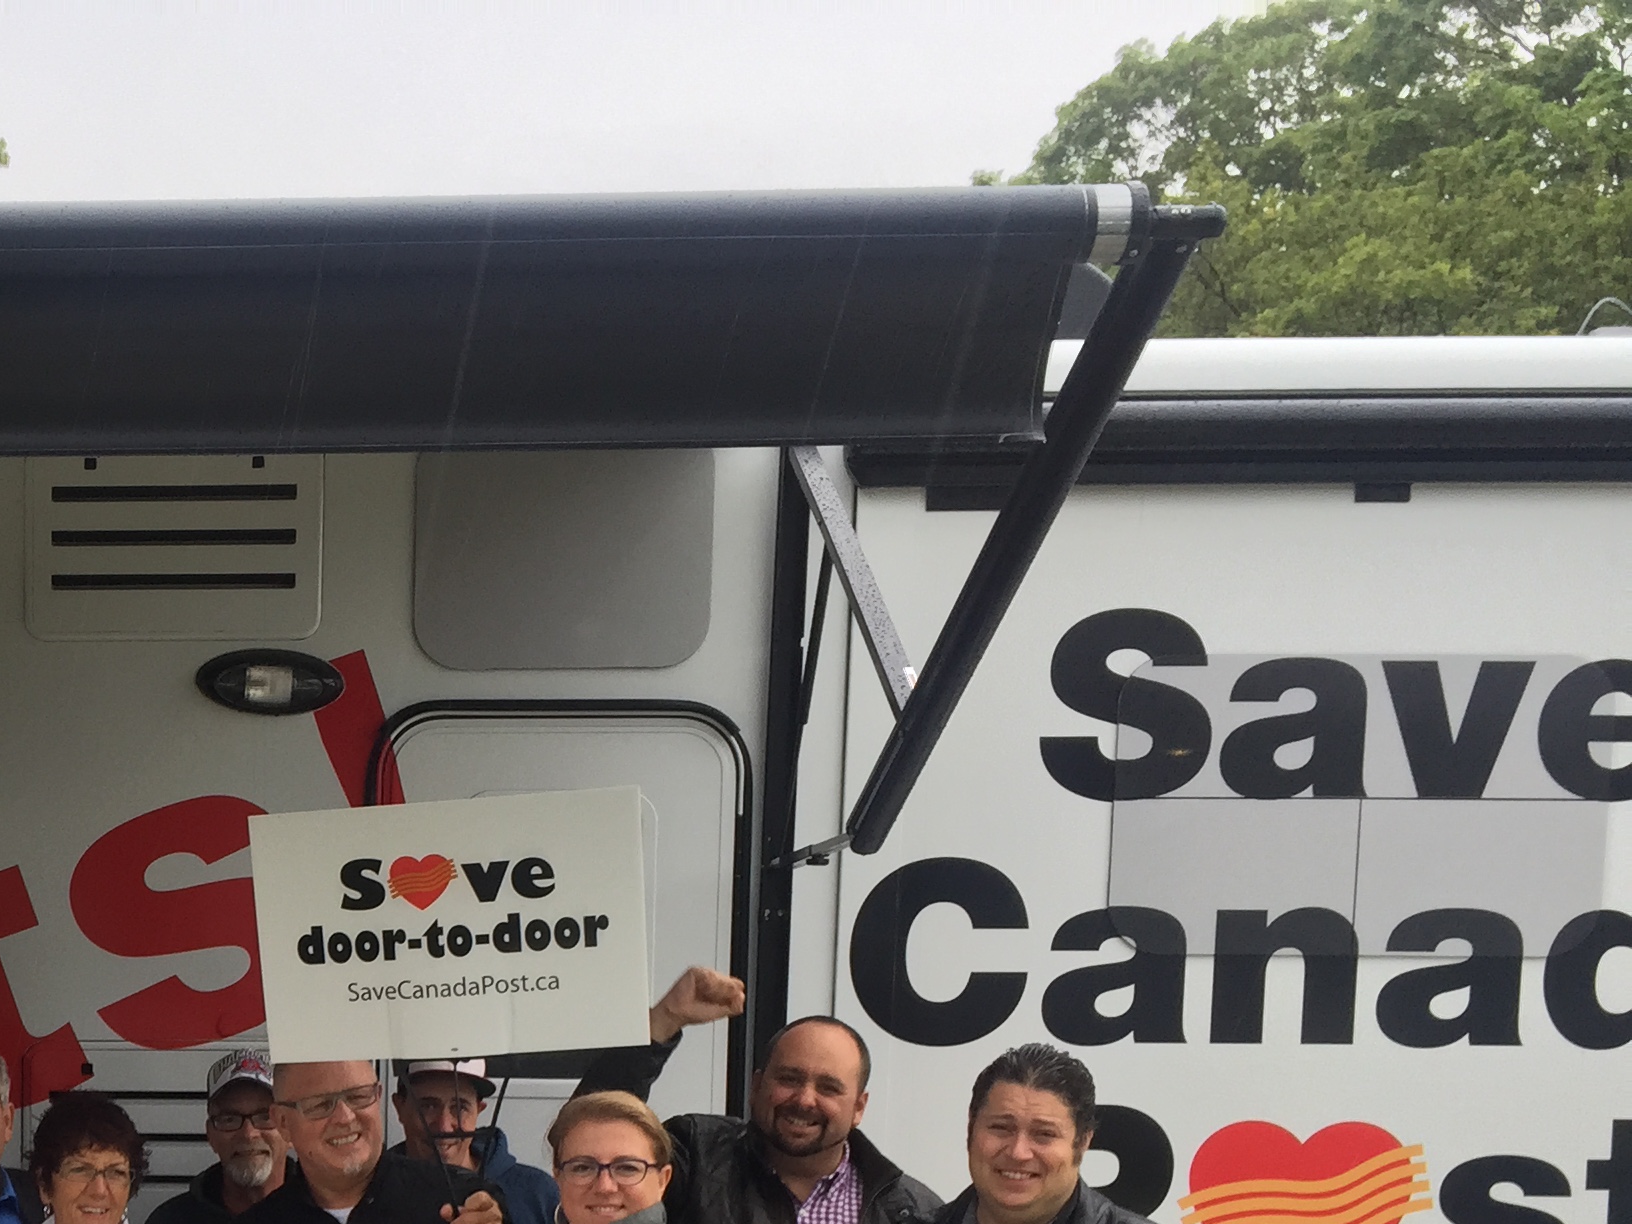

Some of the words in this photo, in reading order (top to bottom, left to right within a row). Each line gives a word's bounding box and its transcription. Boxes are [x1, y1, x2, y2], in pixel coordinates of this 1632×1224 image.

[1039, 607, 1632, 803] Save
[340, 854, 556, 911] Sve
[297, 912, 610, 965] door-to-door
[348, 974, 561, 1002] SaveCanadaPost.ca
